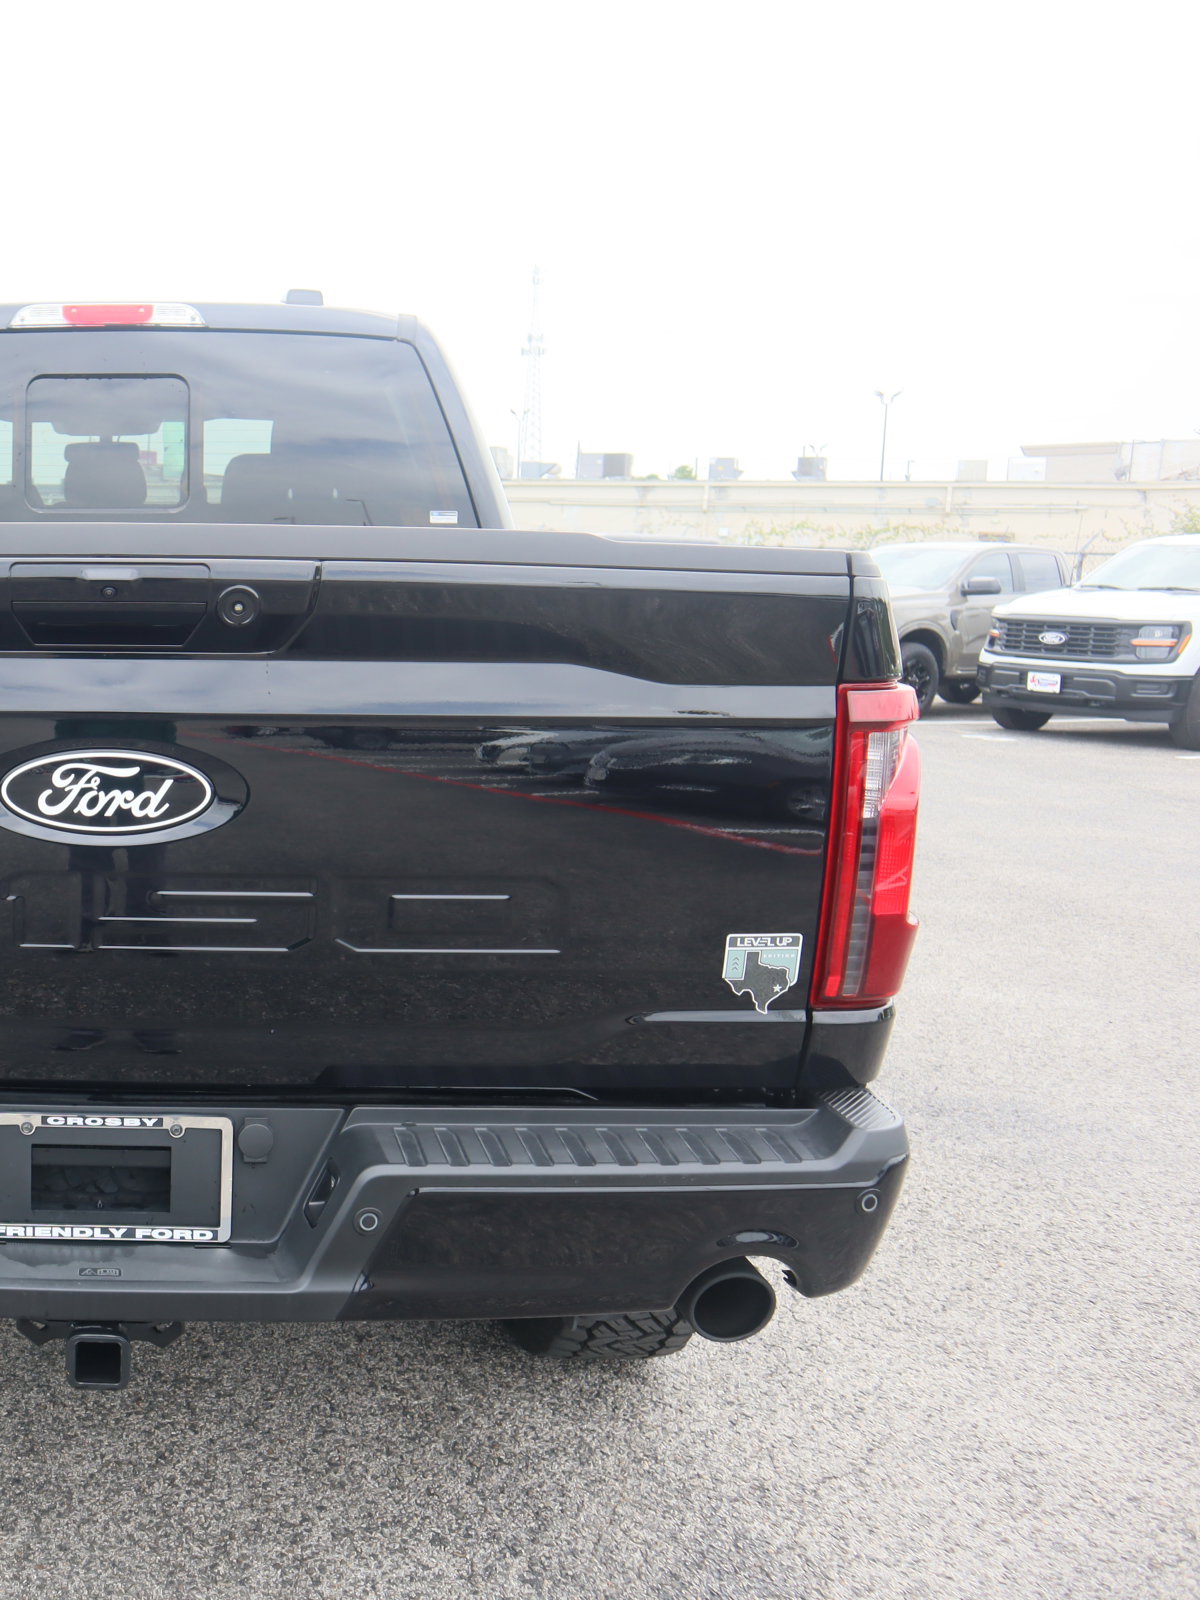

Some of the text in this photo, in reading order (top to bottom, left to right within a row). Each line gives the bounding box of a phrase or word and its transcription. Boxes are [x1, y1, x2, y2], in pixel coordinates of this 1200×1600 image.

[38, 762, 174, 818] Ford
[736, 936, 792, 947] LEVEL UP
[46, 1116, 159, 1128] CROSBY
[135, 1228, 214, 1240] FORD
